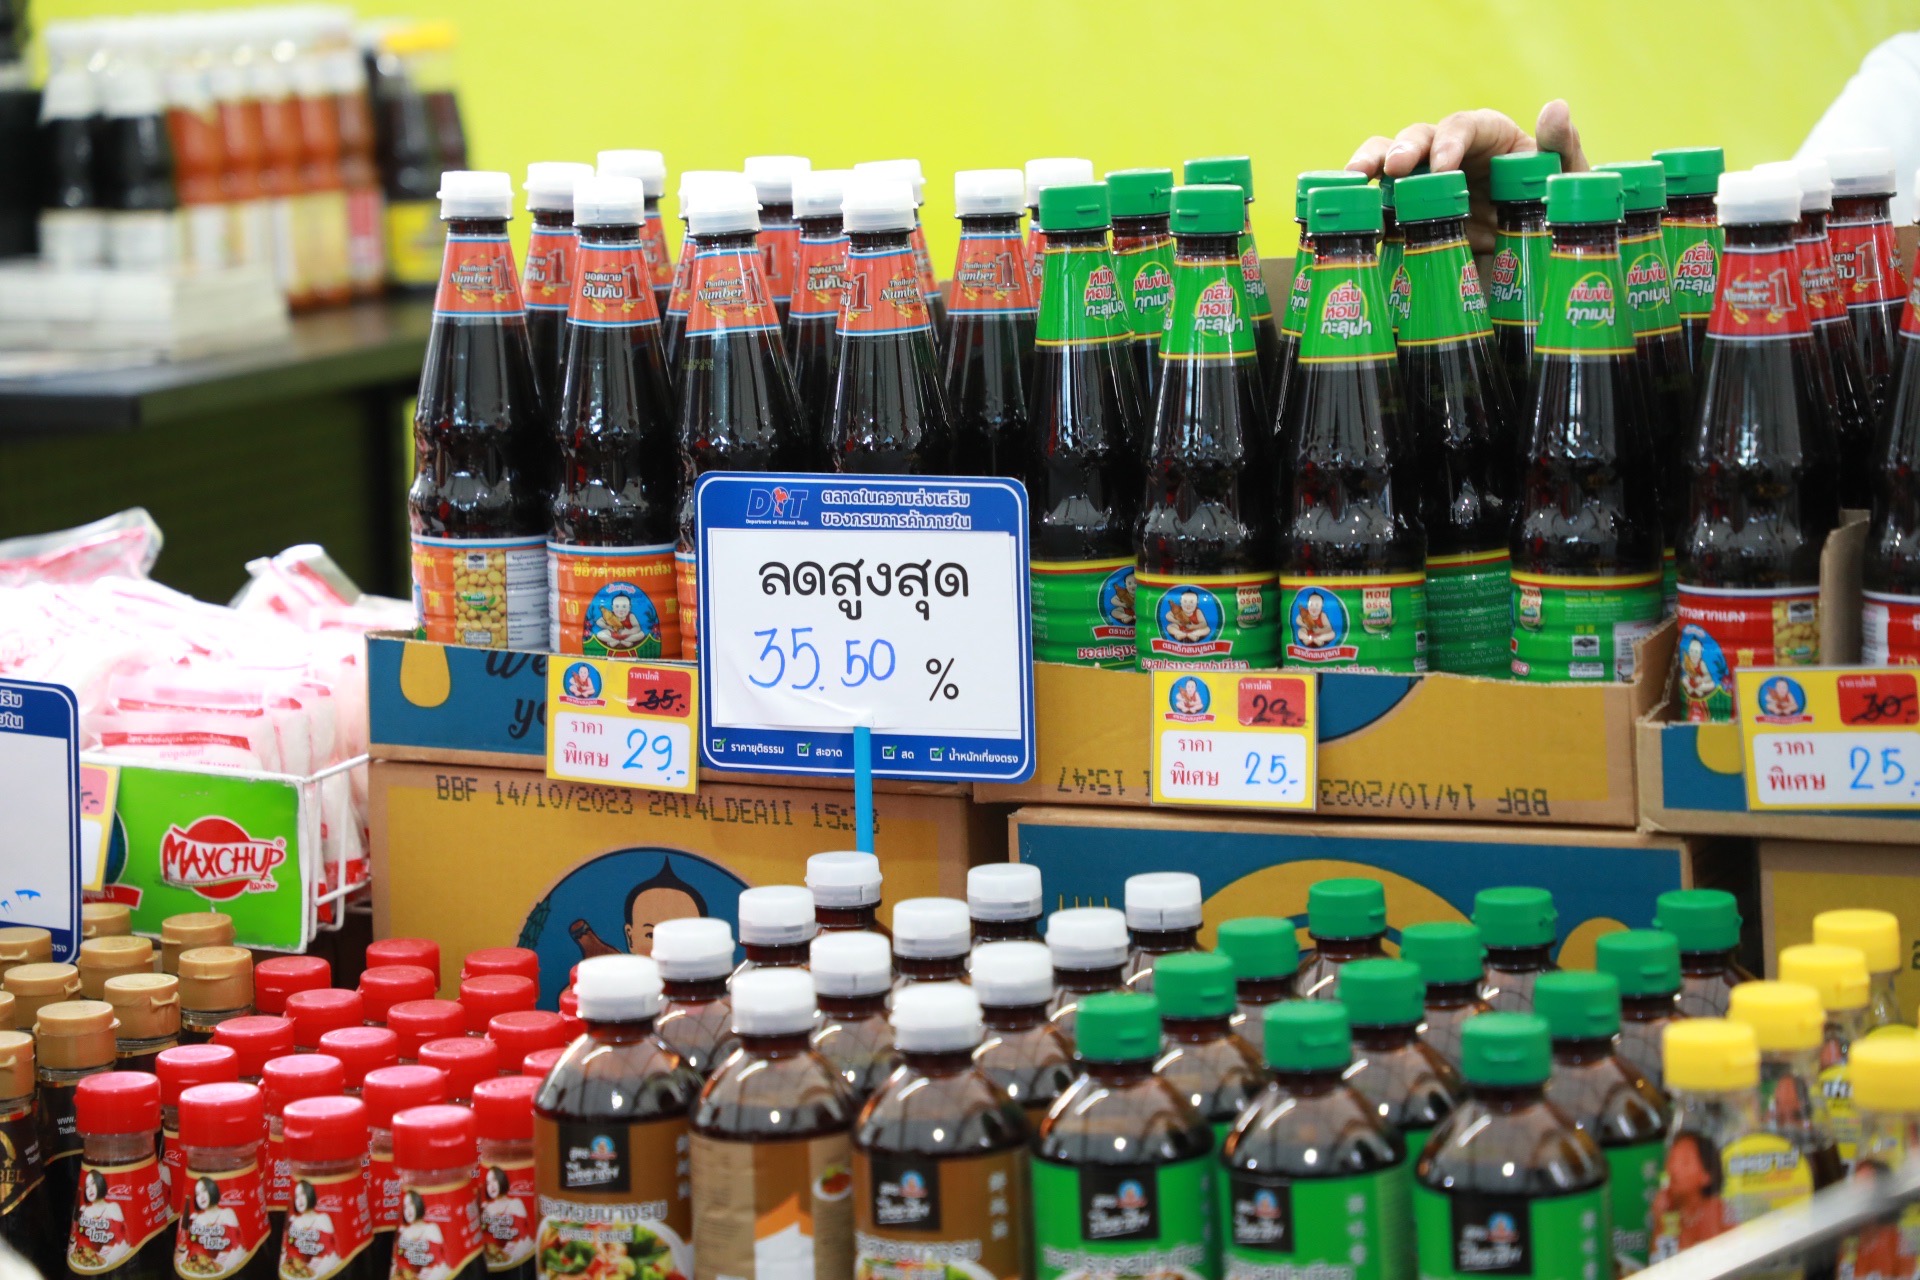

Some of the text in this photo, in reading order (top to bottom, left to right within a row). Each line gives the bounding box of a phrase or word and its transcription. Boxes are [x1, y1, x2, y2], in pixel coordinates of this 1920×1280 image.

[546, 248, 571, 288] 1
[995, 252, 1020, 291] 1
[1677, 263, 1712, 278] หอม
[1855, 240, 1883, 283] 1
[449, 255, 515, 293] Number 1
[582, 282, 624, 299] อันดับ
[622, 263, 646, 303] 1
[584, 271, 622, 282] ยอดขาย
[1627, 262, 1667, 286] เข้มข้น
[697, 267, 767, 306] Number 1
[853, 272, 872, 312] 1
[1085, 286, 1111, 301] หอม
[1203, 278, 1234, 301] กลิ่น
[1329, 279, 1361, 304] กลิ่น
[1568, 281, 1614, 302] เข้มข้น
[1768, 268, 1797, 313] 1
[1198, 301, 1232, 317] หอม
[1627, 287, 1671, 311] ทุกเมนู
[1324, 303, 1360, 320] หอม
[1566, 306, 1616, 327] ทุกเมนู
[1194, 313, 1243, 336] ทะลุฝา
[1321, 316, 1372, 340] ทะลุฝา
[821, 487, 970, 507] ตลาดในความส่งเสริม
[821, 509, 971, 529] ของกรมการค้าภายใน
[758, 558, 969, 620] ลดสูงสุด
[1365, 590, 1389, 599] หอม
[1108, 626, 1135, 636] ตราเด็ก
[748, 627, 960, 701] 35.50 %
[571, 720, 603, 735] ราคา
[563, 741, 609, 768] พิเศษ
[731, 743, 1019, 764] ราคายุติธรรม สะอาด สด น้ำหนักเที่ยงตรง
[1178, 737, 1213, 753] ราคา
[1773, 741, 1815, 755] ราคา
[1170, 761, 1219, 787] พิเศษ
[1768, 766, 1826, 791] พิเศษ
[436, 774, 478, 801] BBF
[494, 780, 634, 815] 14/10/2023
[1319, 778, 1474, 811] 14/10/2023
[1497, 788, 1552, 817] BBF
[162, 832, 285, 882] MAXCHUP
